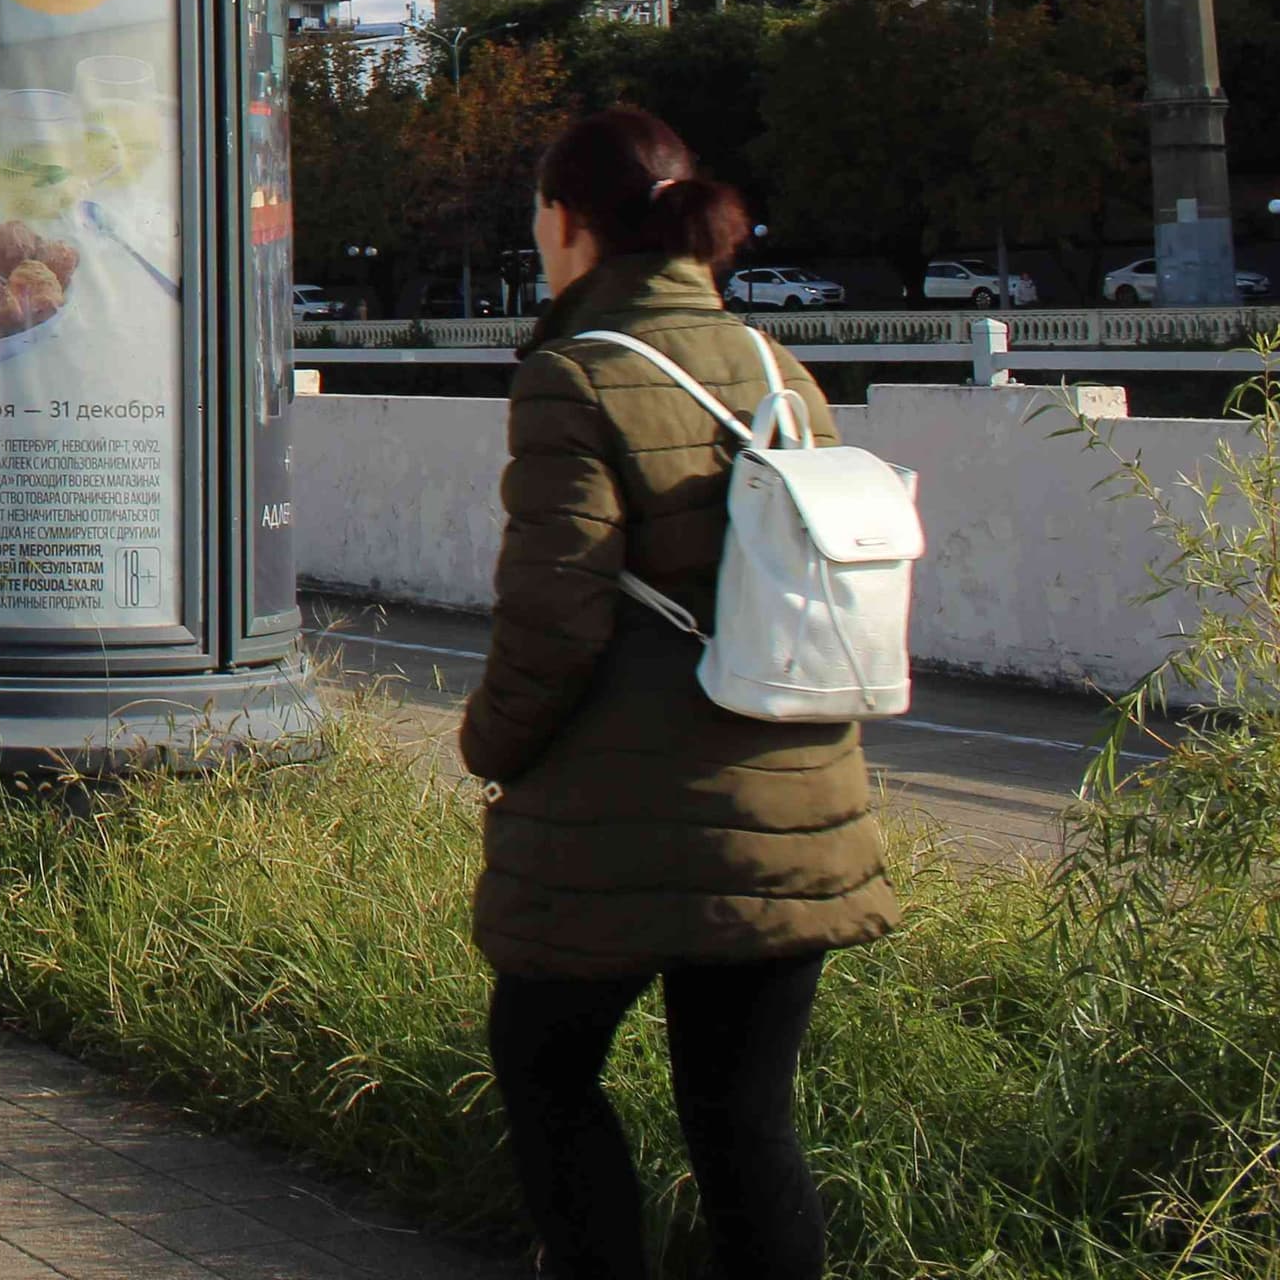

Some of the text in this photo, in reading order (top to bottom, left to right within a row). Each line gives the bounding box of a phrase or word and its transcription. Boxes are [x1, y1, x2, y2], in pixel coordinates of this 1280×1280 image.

[50, 400, 69, 417] 31
[76, 399, 165, 423] декабря
[63, 437, 106, 452] НЕВСКИЙ
[41, 457, 130, 470] ИСПОЛЬЗОВАНИЕМ
[131, 457, 160, 470] КАРТЫ
[16, 474, 68, 489] ПРОХОДИТ
[69, 474, 83, 487] ВО
[84, 474, 106, 487] ВСЕХ
[107, 474, 160, 487] МАГАЗИНАХ
[25, 492, 61, 505] ТОВАРА
[130, 492, 160, 506] АКЦИИ
[8, 508, 89, 521] НЕЗНАЧИТЕЛЬНО
[91, 508, 148, 521] ОТЛИЧАТЬСЯ
[149, 508, 160, 521] ОТ
[24, 527, 36, 539] НЕ
[38, 527, 108, 539] СУММИРУЕТСЯ
[116, 527, 160, 541] ДРУГИМИ
[19, 544, 103, 558] МЕРОПРИЯТИЯ,
[23, 578, 104, 592] POSUDA.5KA.RU
[122, 550, 158, 607] 18+
